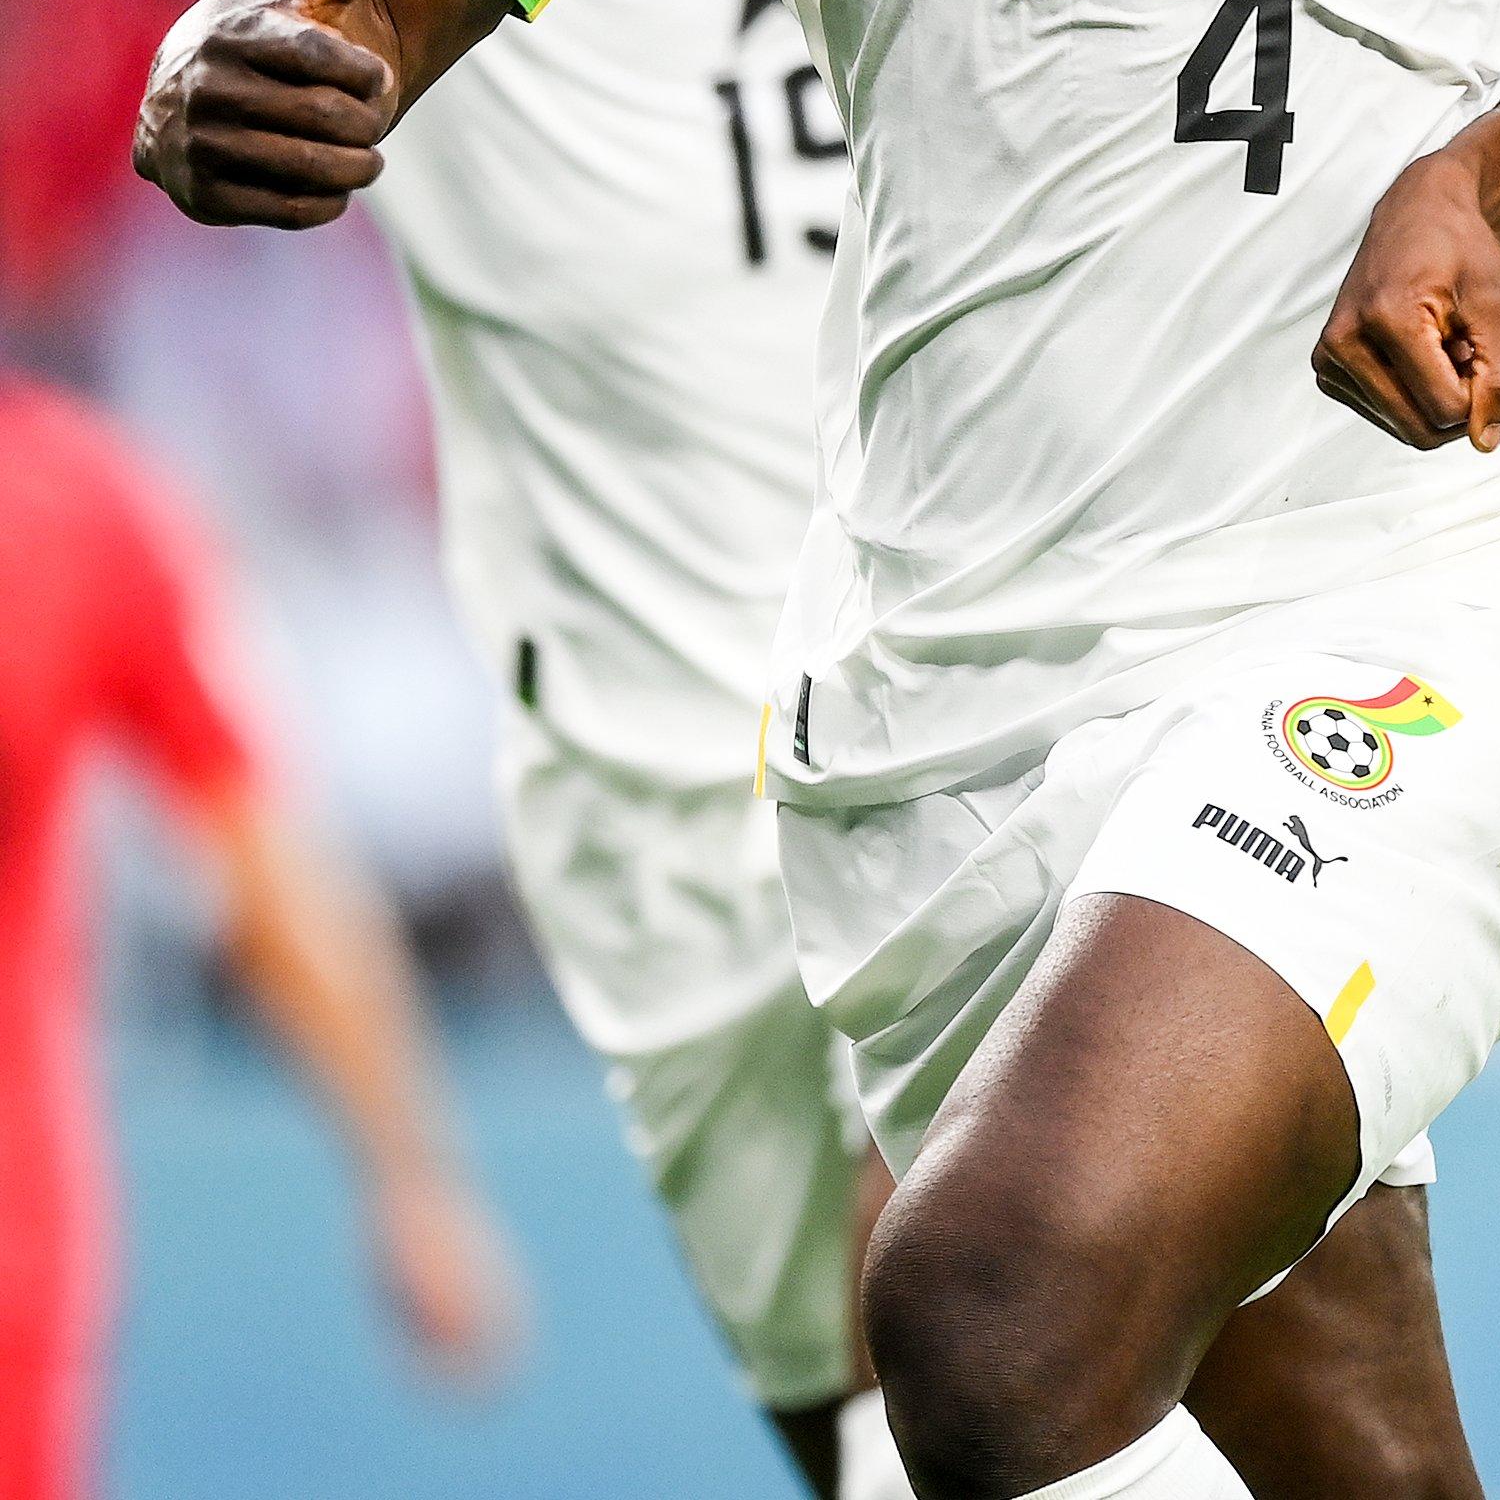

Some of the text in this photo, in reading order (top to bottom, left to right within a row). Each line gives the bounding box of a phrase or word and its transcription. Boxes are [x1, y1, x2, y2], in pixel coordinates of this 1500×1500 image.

[1261, 699, 1404, 810] GHANA FOOTBALL ASSOCIATION
[1192, 803, 1306, 884] PUMA
